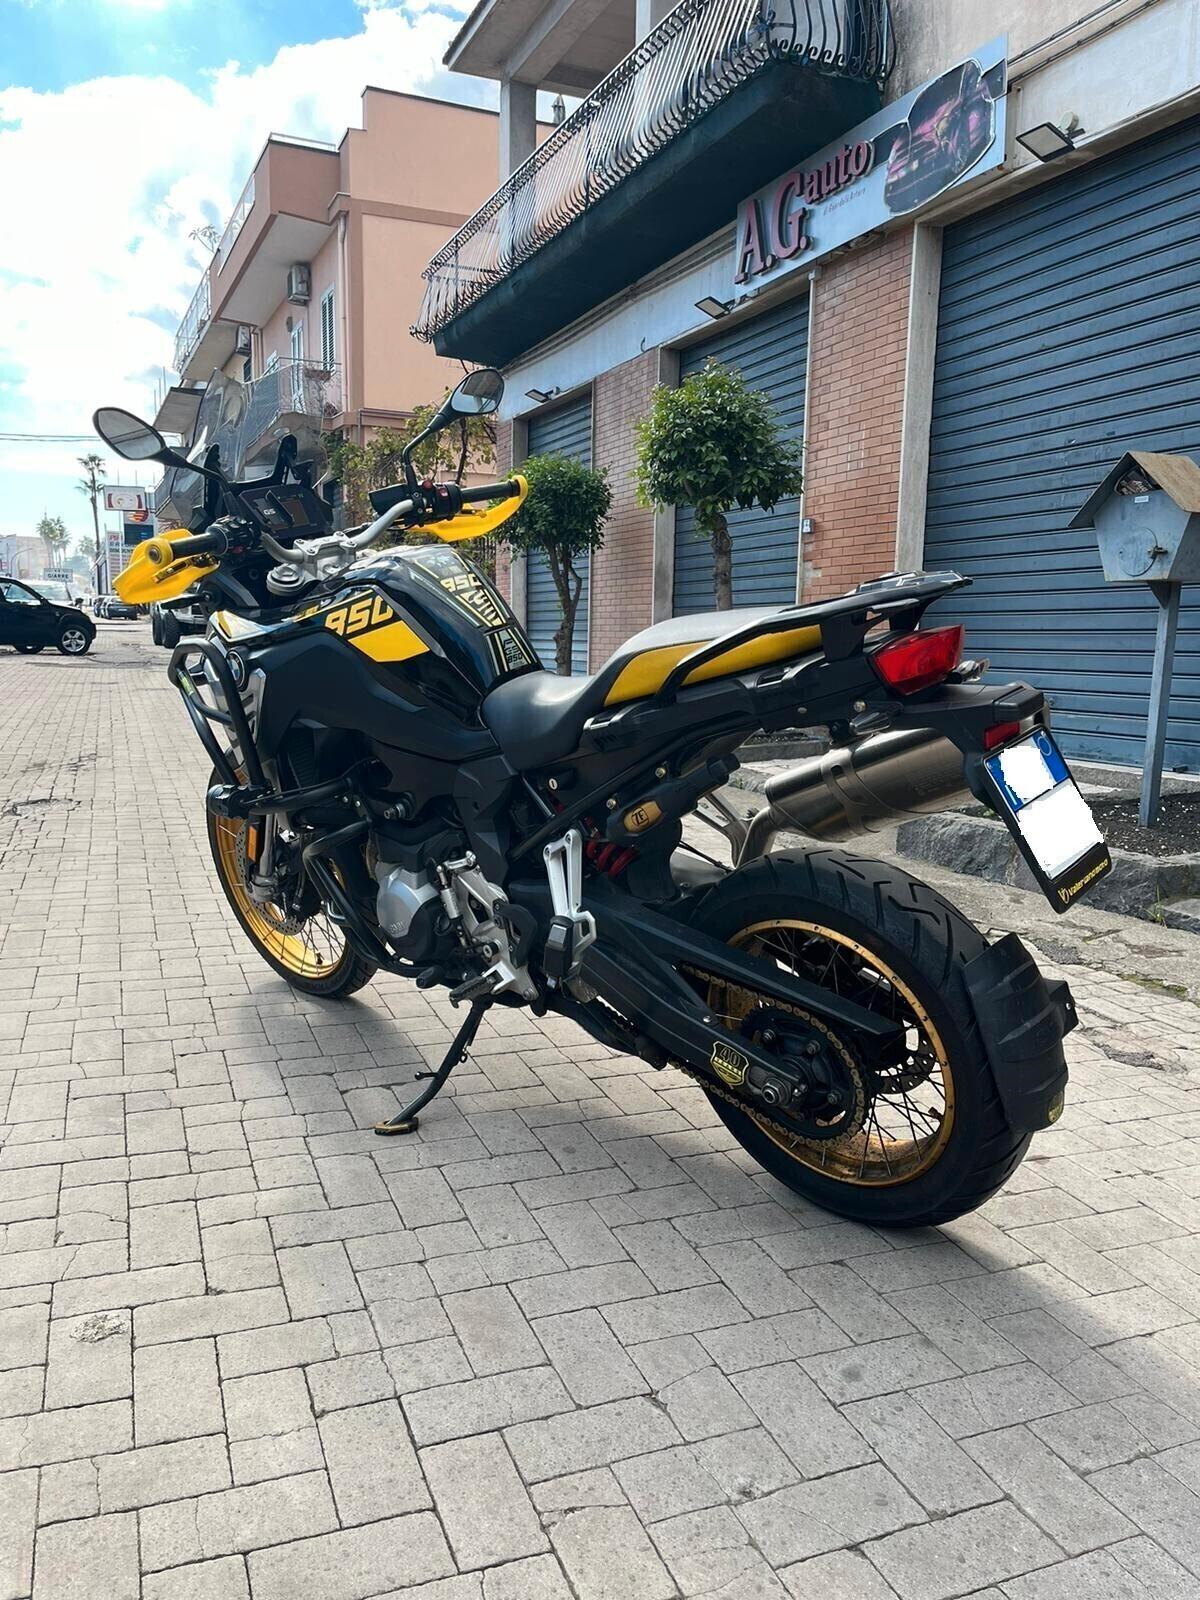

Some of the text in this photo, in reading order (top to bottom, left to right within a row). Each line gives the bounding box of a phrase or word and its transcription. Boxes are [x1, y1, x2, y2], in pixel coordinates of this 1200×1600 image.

[804, 139, 875, 205] auto
[507, 653, 523, 663] 850
[720, 1046, 741, 1067] 40
